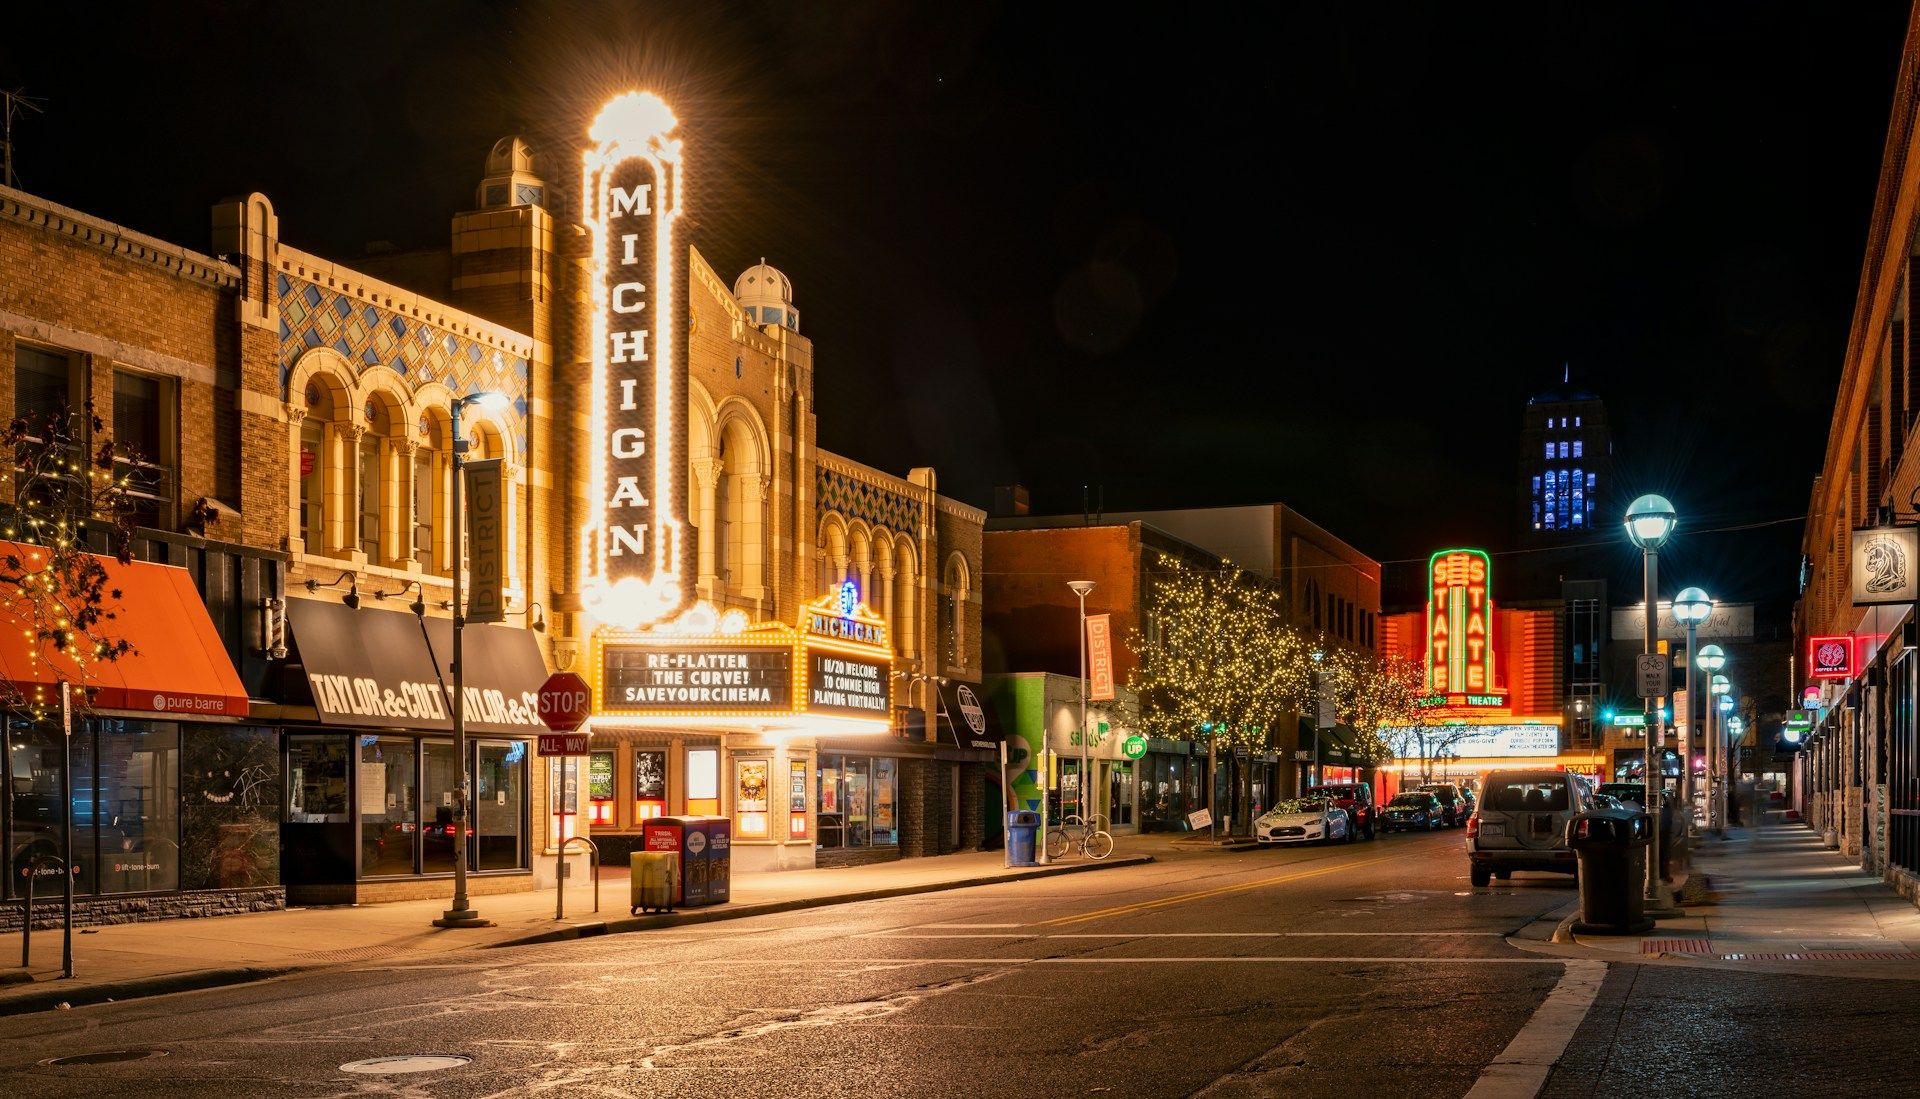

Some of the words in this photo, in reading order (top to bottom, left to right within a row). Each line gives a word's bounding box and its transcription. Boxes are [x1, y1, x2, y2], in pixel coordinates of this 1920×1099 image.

[608, 184, 652, 556] MICHIGAN
[474, 477, 494, 608] DISTRICT
[812, 614, 883, 645] MICHIGAN
[1434, 561, 1448, 690] STATE
[1467, 560, 1485, 688] STATE
[648, 654, 748, 668] RE-FLATTEN
[1092, 623, 1108, 692] DISTRICT
[653, 671, 684, 685] THE
[690, 671, 750, 685] CURVE!
[845, 661, 878, 679] WELCOME
[625, 688, 771, 702] SAVEYOURCINEMA
[823, 675, 833, 688] TO
[863, 680, 880, 695] HIGH
[167, 697, 193, 710] pure
[194, 697, 224, 711] barre
[310, 673, 446, 720] TAYLOR&COLT
[541, 691, 587, 713] STOP
[814, 689, 846, 706] PLAYING
[847, 694, 886, 711] VIRTUALLY
[1467, 696, 1503, 707] THEATRE
[565, 738, 586, 751] WAY
[1127, 745, 1143, 755] UP
